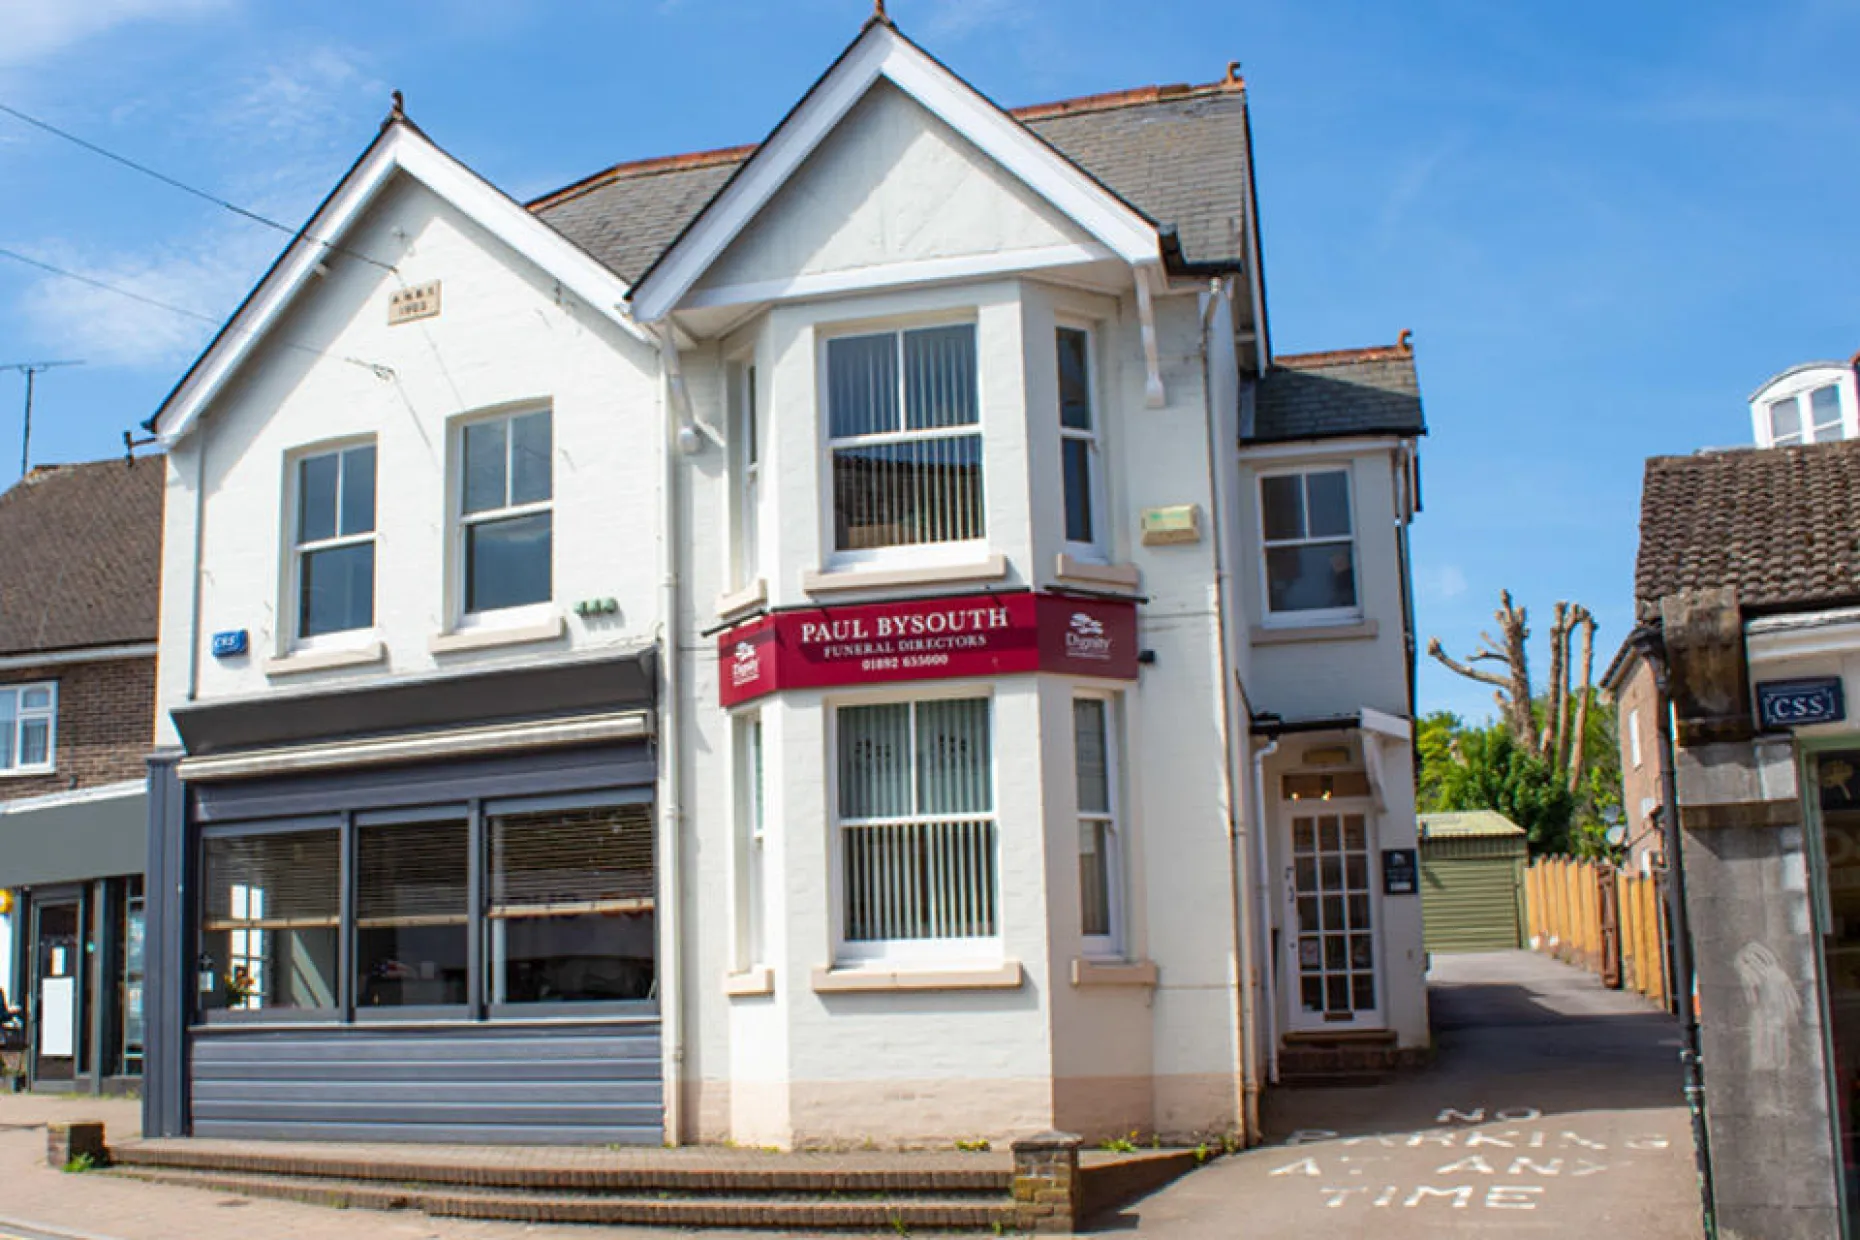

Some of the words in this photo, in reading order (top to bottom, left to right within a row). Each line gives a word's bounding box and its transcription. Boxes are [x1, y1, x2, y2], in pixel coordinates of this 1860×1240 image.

[802, 619, 868, 642] PAUL
[877, 607, 1008, 636] BYSOUTH
[824, 644, 894, 658] FUNERAL
[898, 634, 987, 650] DIRECTORS
[1774, 696, 1823, 717] CSS
[1436, 1107, 1541, 1122] NO
[1285, 1129, 1669, 1149] PARKING
[1436, 1154, 1634, 1175] ANY
[1320, 1186, 1544, 1209] TIME
